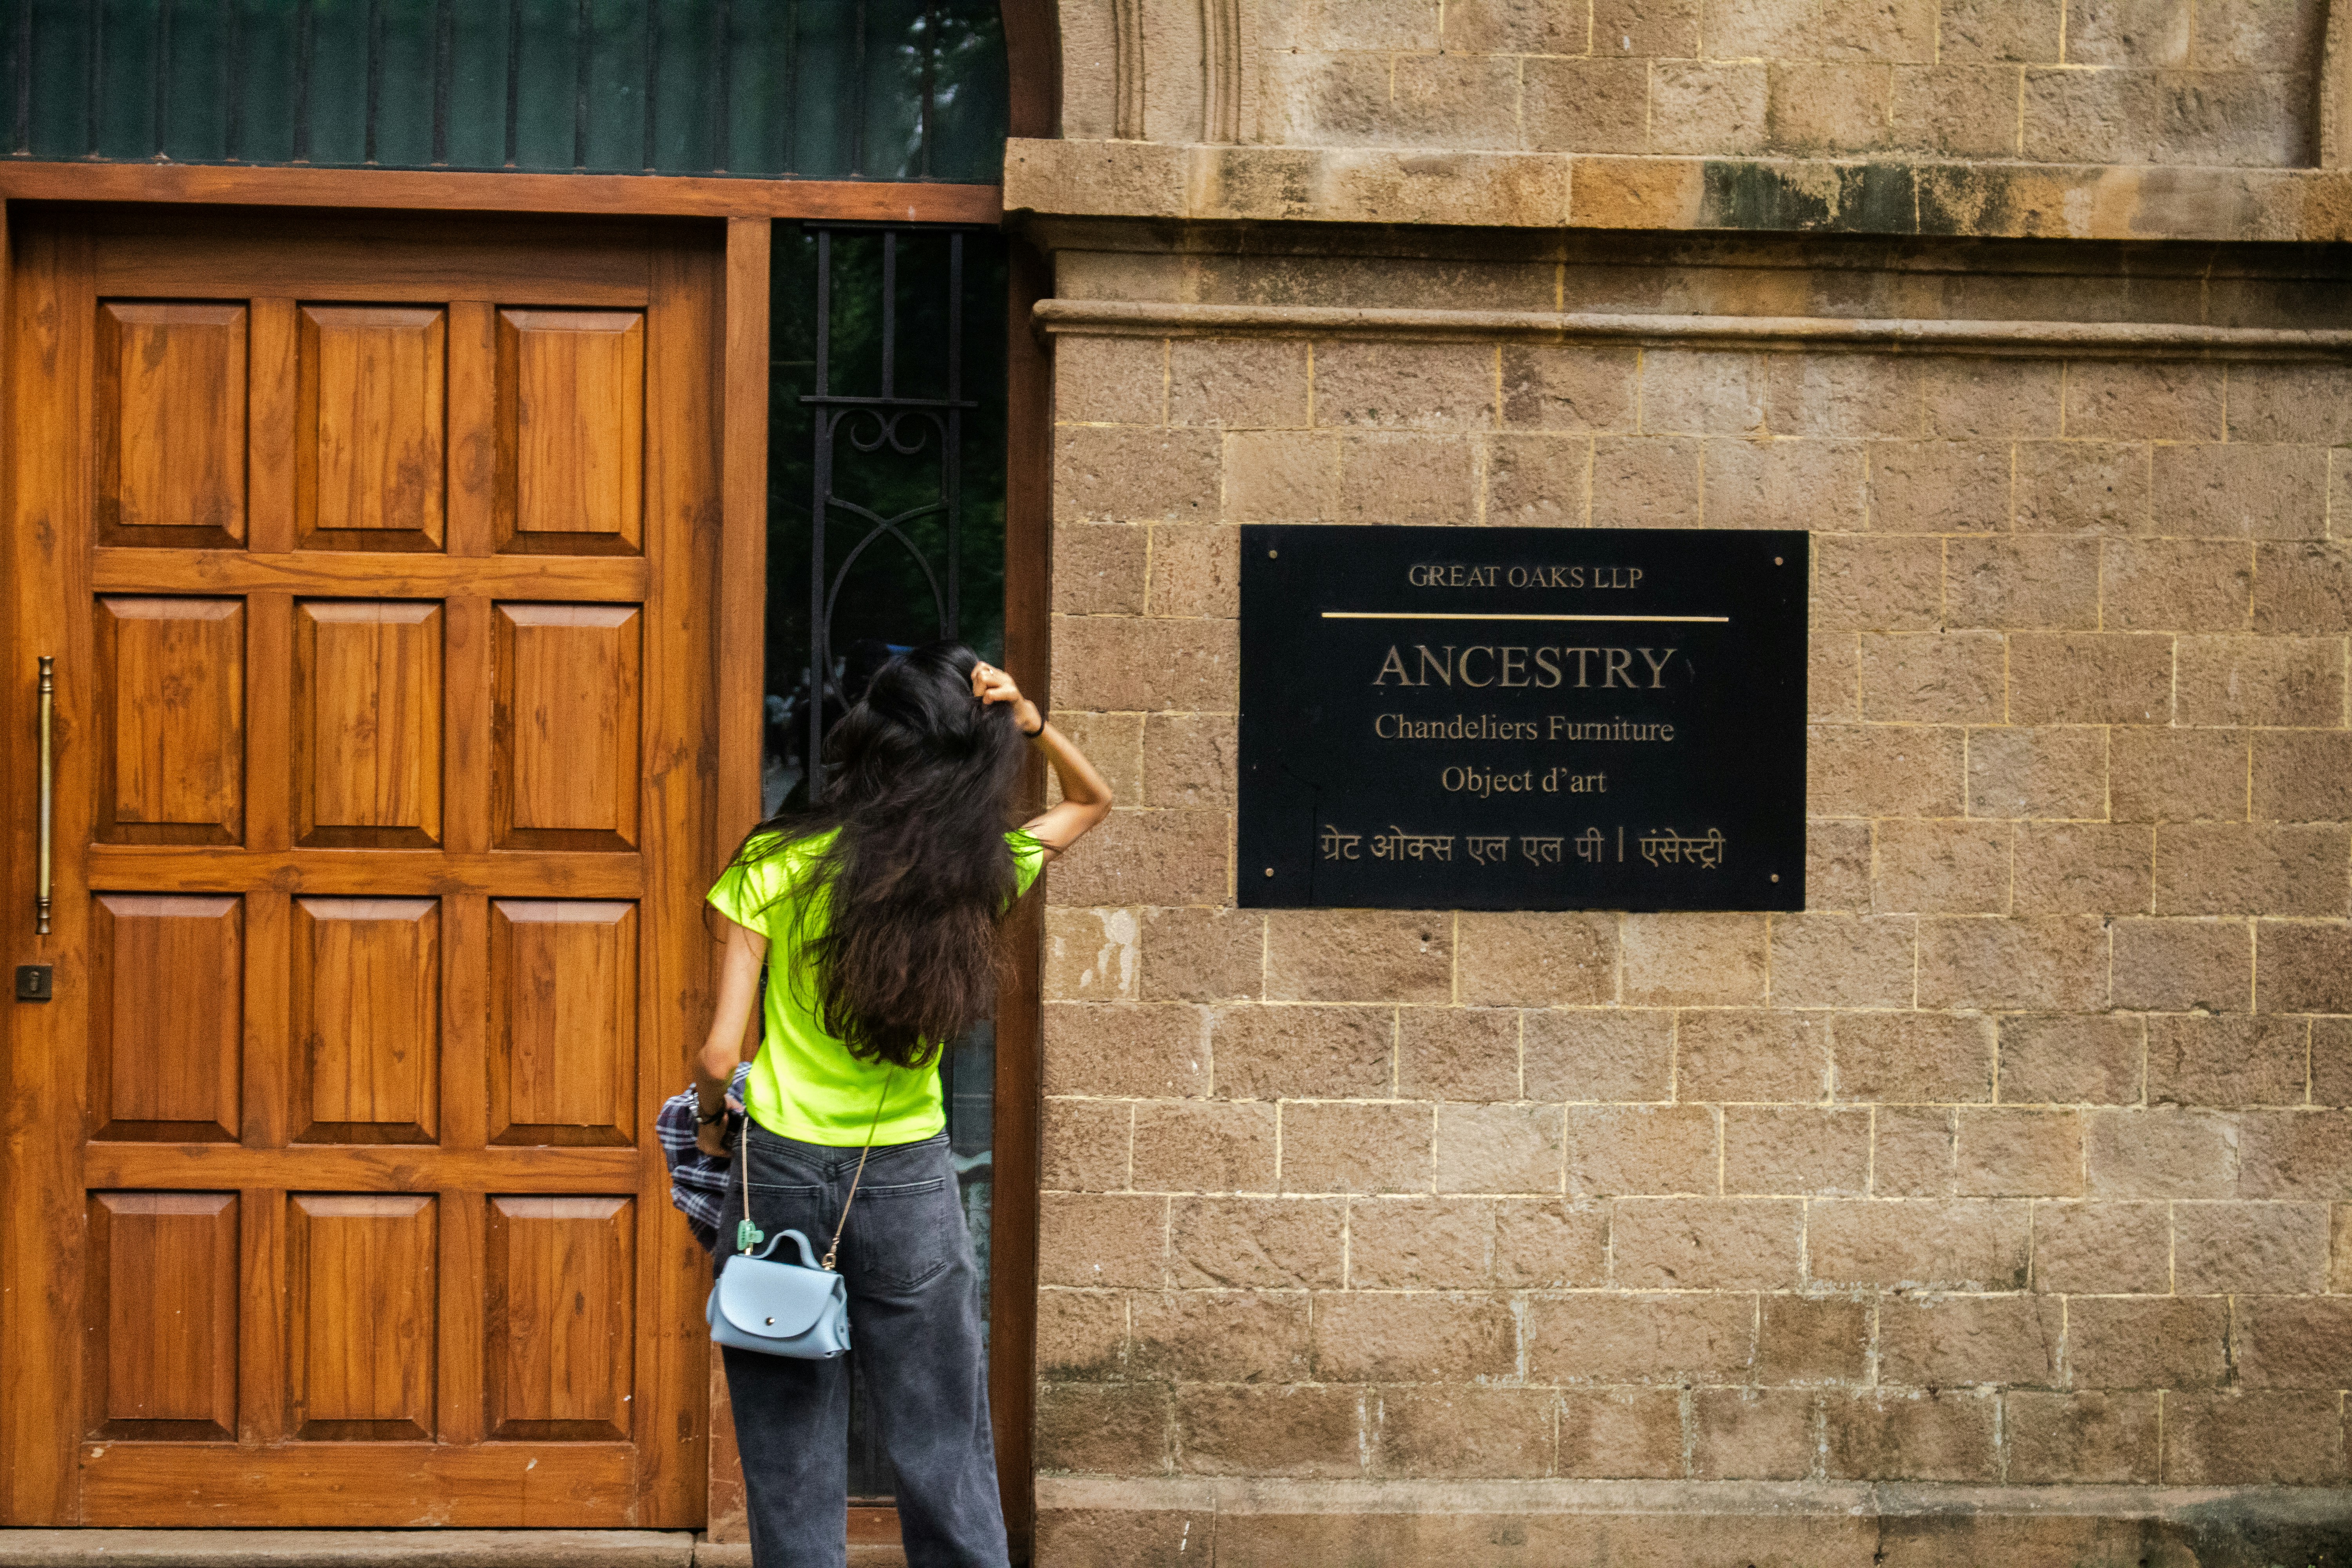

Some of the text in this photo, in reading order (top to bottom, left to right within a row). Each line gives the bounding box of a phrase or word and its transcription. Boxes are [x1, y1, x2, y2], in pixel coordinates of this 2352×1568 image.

[1409, 565, 1643, 588] GREAT OAKS LLP
[1373, 645, 1677, 688] ANCESTRY
[1375, 714, 1674, 742] Chandeliers Furniture
[1442, 766, 1532, 798] Object
[1321, 824, 1362, 860] ग्रेट
[1370, 824, 1455, 861] ओक्स
[1466, 836, 1510, 866] एल
[1520, 836, 1564, 867] एल
[1575, 827, 1604, 862] पी
[1639, 828, 1726, 869] एंसेस्ट्री
